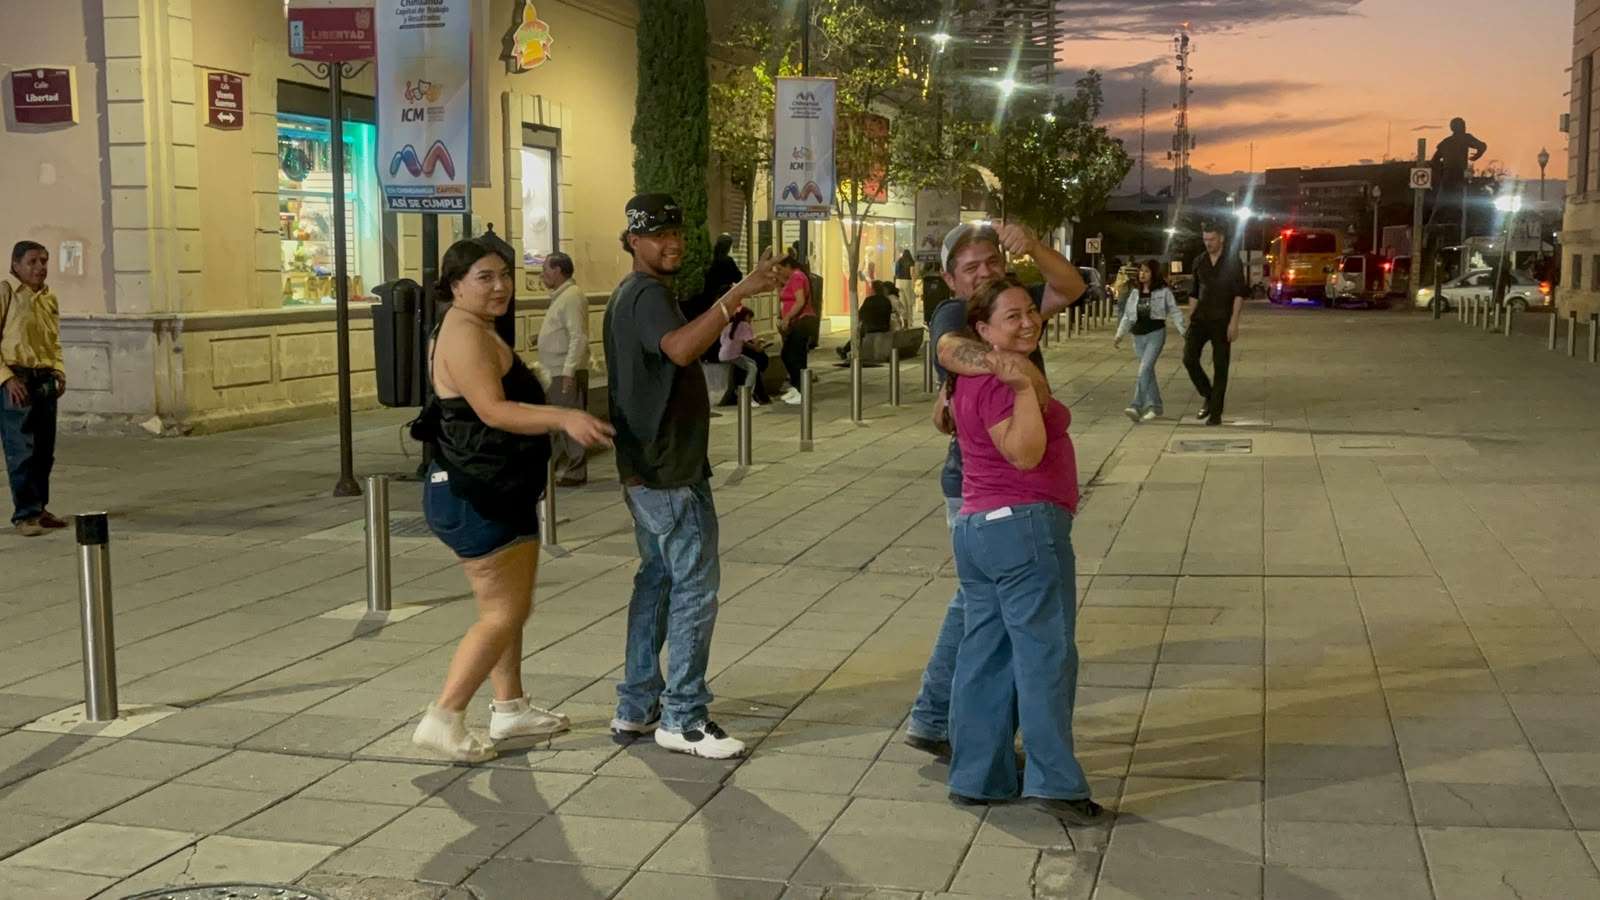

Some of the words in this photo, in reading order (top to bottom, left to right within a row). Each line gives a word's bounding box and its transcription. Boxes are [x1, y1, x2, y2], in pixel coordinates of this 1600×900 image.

[311, 30, 366, 41] LIBERTAD
[25, 93, 59, 103] Libertad
[401, 107, 425, 122] ICM
[422, 198, 464, 209] CUMPLE
